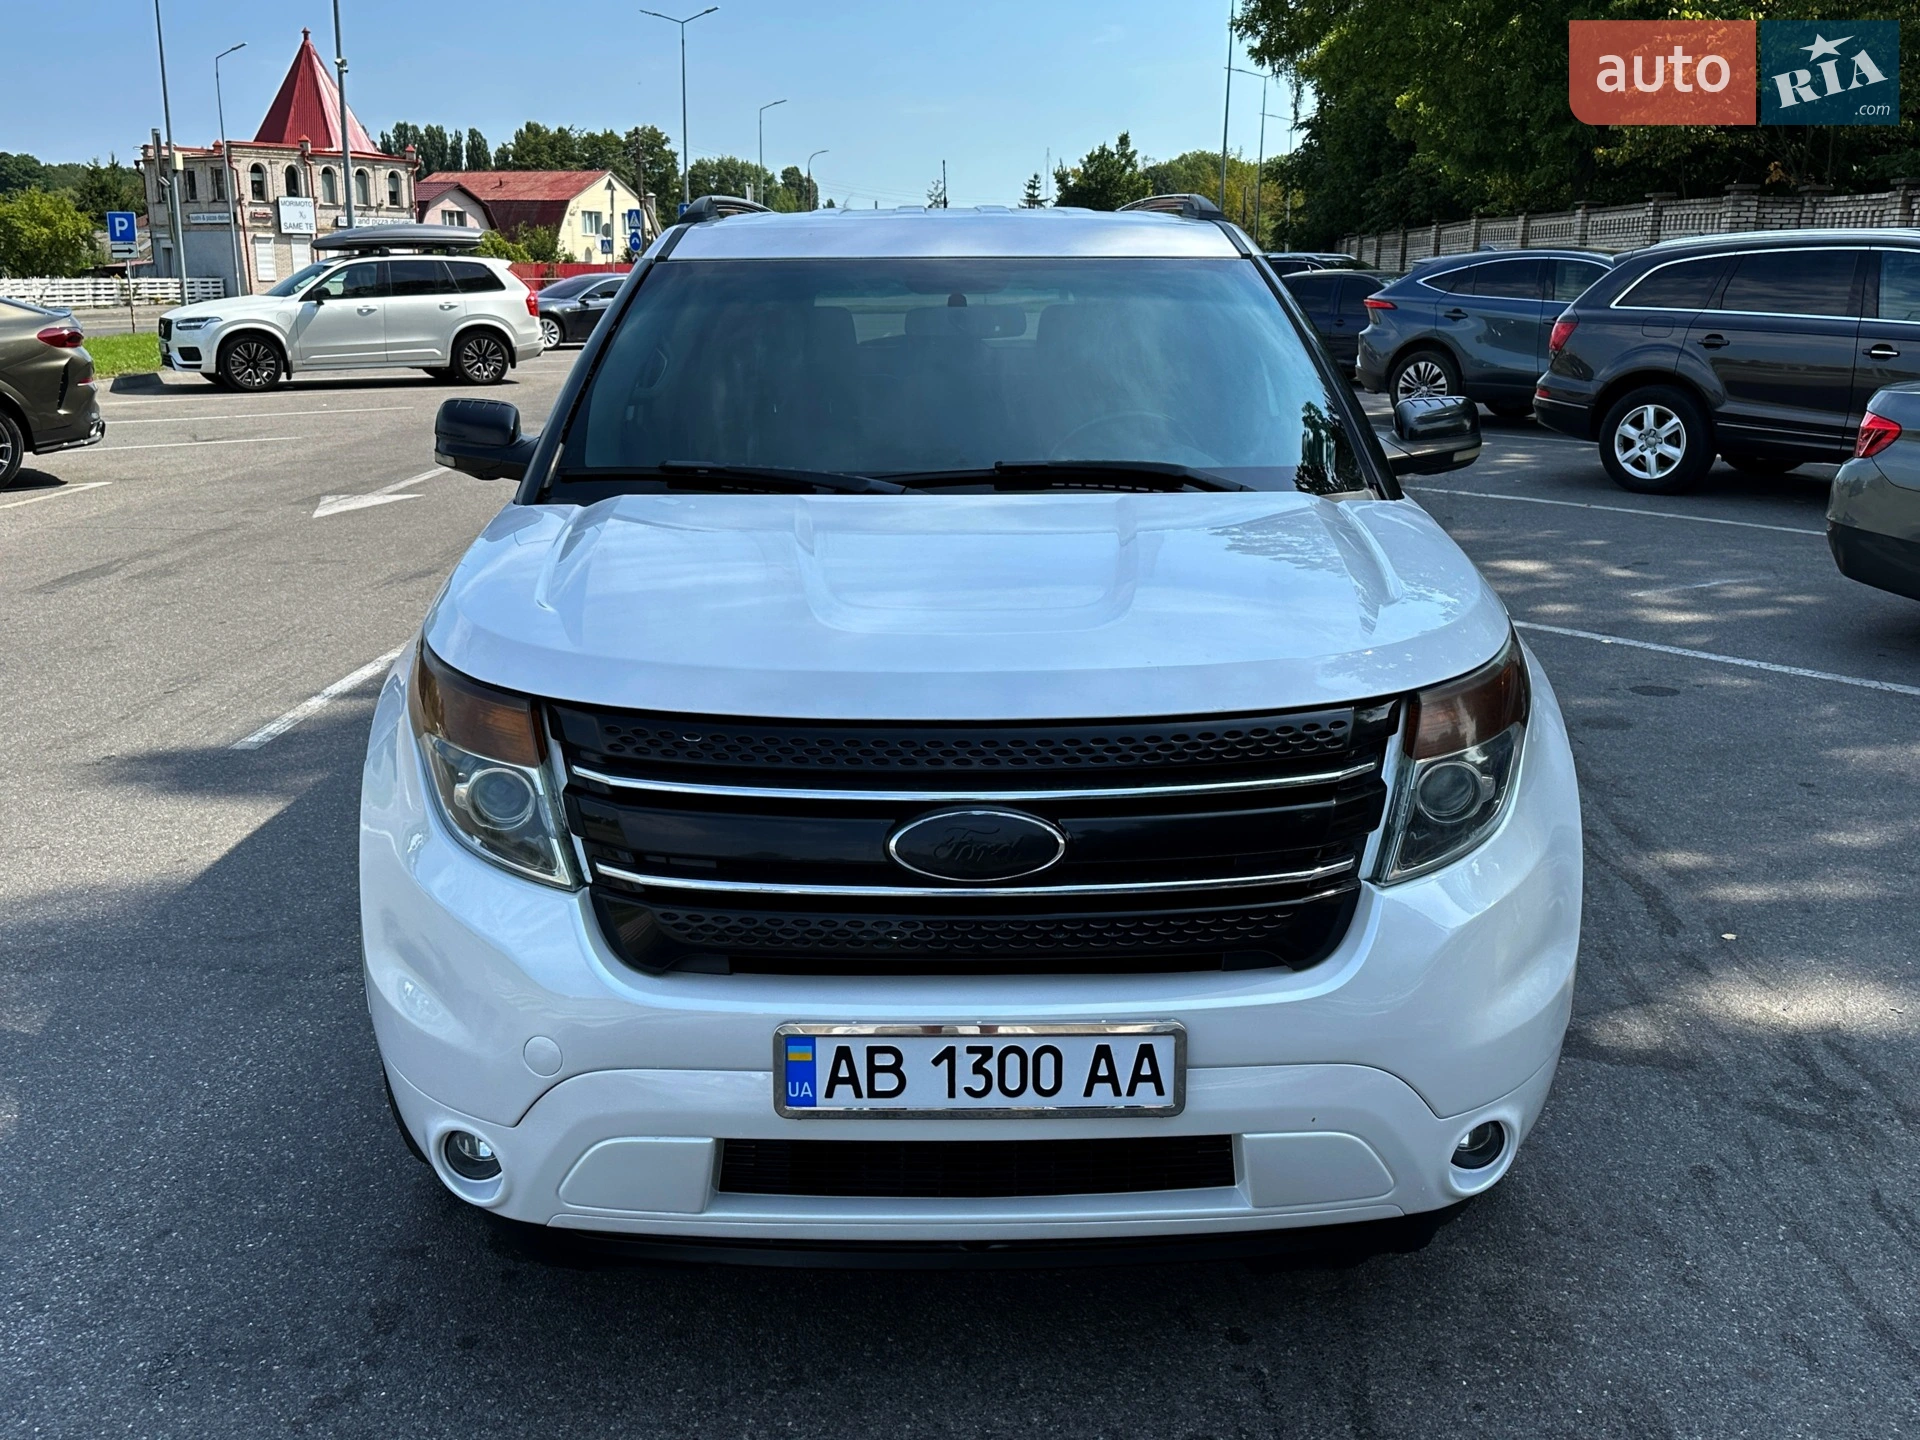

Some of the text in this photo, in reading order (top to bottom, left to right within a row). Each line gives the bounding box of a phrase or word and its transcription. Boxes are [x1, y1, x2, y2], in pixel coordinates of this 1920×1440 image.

[114, 217, 129, 237] P
[284, 222, 303, 230] SAME
[933, 826, 1024, 862] Ford
[824, 1043, 1166, 1099] AB 1300 AA
[788, 1081, 813, 1098] UA
